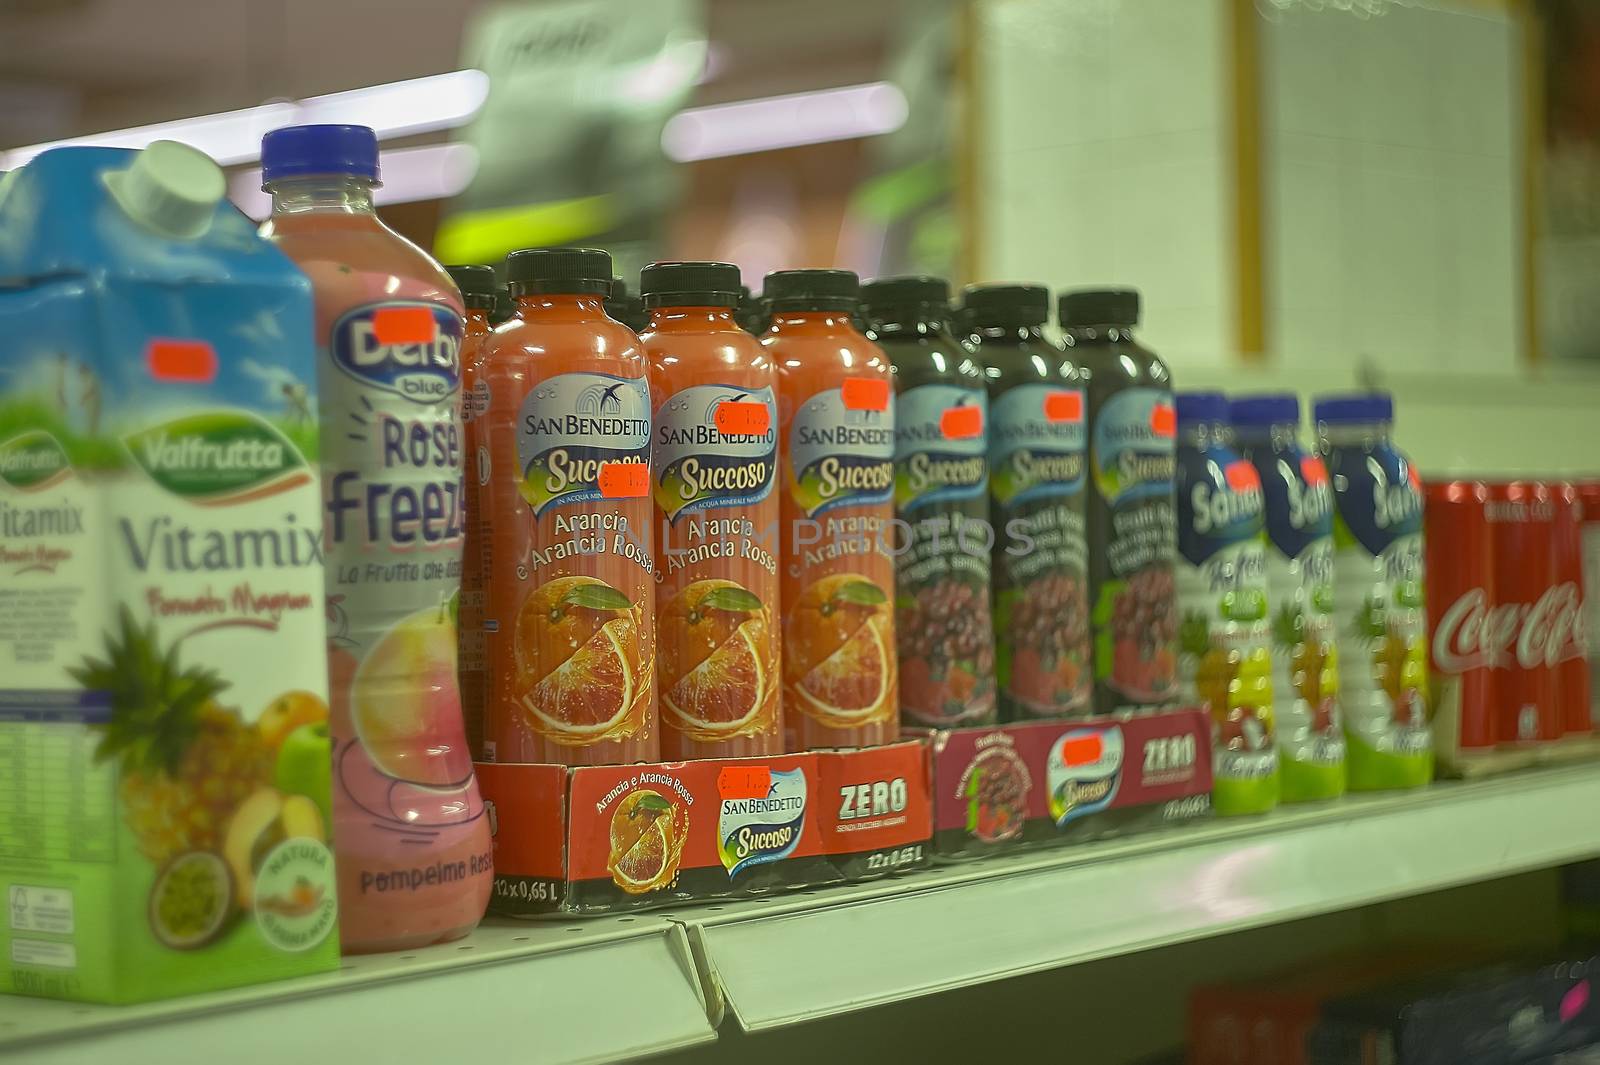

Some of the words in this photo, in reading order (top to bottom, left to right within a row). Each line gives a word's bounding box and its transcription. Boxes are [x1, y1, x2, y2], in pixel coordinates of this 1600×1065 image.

[402, 379, 445, 395] blue
[145, 434, 285, 470] Valfrutta
[679, 458, 765, 500] Succoso
[0, 497, 86, 538] itamix
[554, 511, 628, 536] Arancia
[687, 515, 753, 541] Arancia
[118, 513, 325, 573] Vitamix
[516, 566, 529, 580] e
[530, 533, 606, 570] Arancia
[612, 534, 654, 575] Rossa
[667, 537, 735, 575] Arancia
[740, 539, 777, 576] Rossa
[596, 780, 630, 814] Arancia
[630, 776, 638, 786] e
[639, 772, 673, 786] Arancia
[673, 778, 694, 806] Rossa
[839, 777, 908, 820] ZERO
[736, 826, 792, 859] Succoso
[550, 883, 558, 900] L
